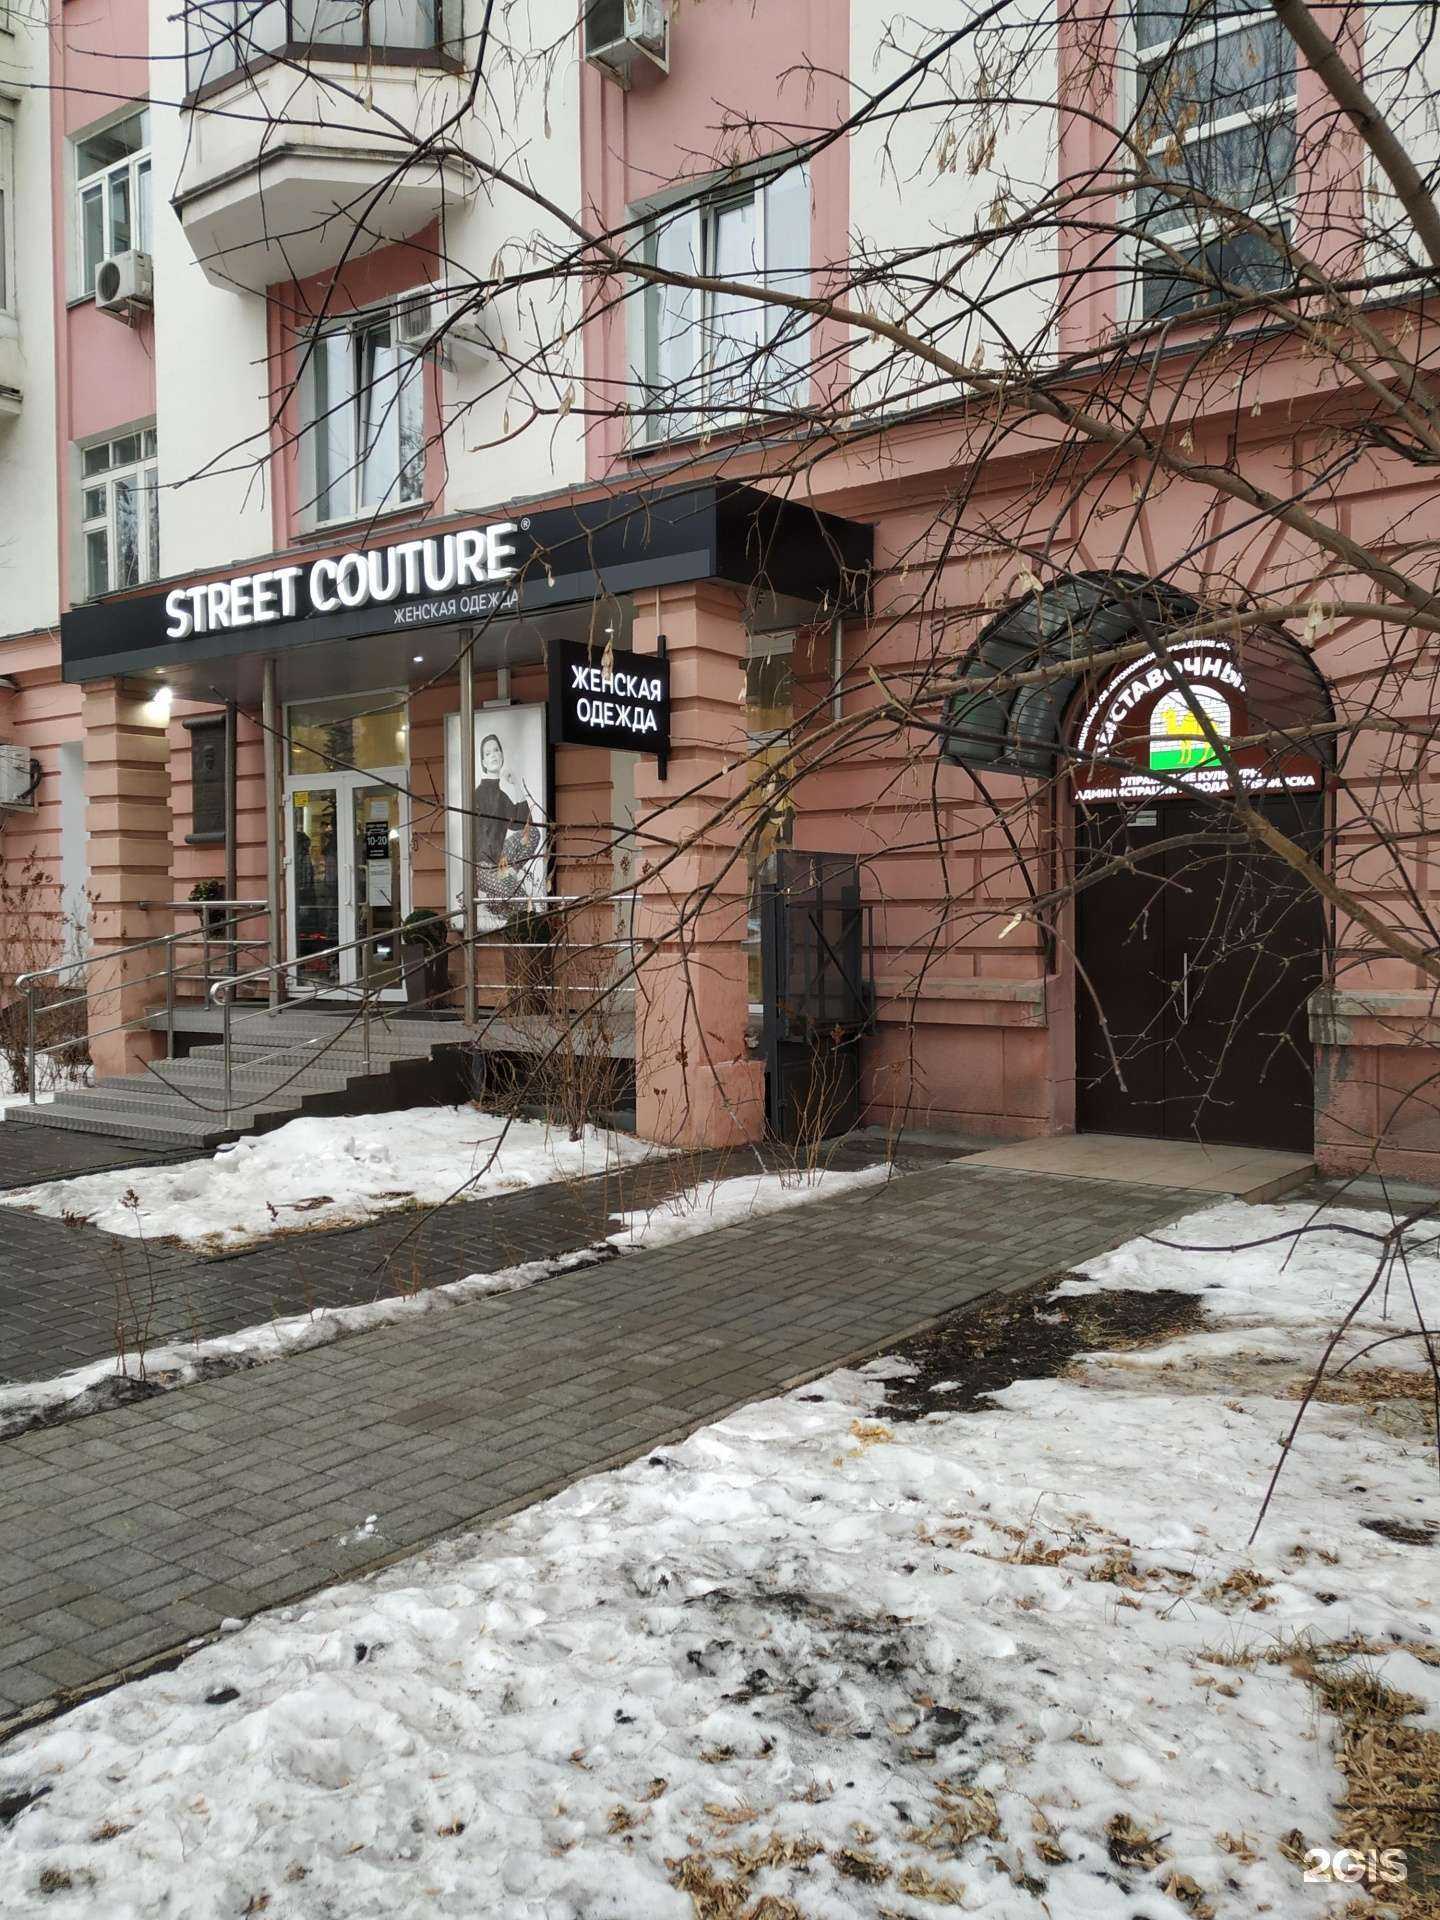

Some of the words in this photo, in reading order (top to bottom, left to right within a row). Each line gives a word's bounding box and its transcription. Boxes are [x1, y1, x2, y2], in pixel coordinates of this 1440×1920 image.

[165, 566, 303, 638] STREET
[310, 521, 519, 611] COUTURE
[393, 599, 456, 624] ЖЕНСКАЯ
[460, 589, 519, 614] ОДЕЖДА
[571, 665, 661, 702] ЖЕНСКАЯ
[576, 698, 658, 733] ОДЕЖДА
